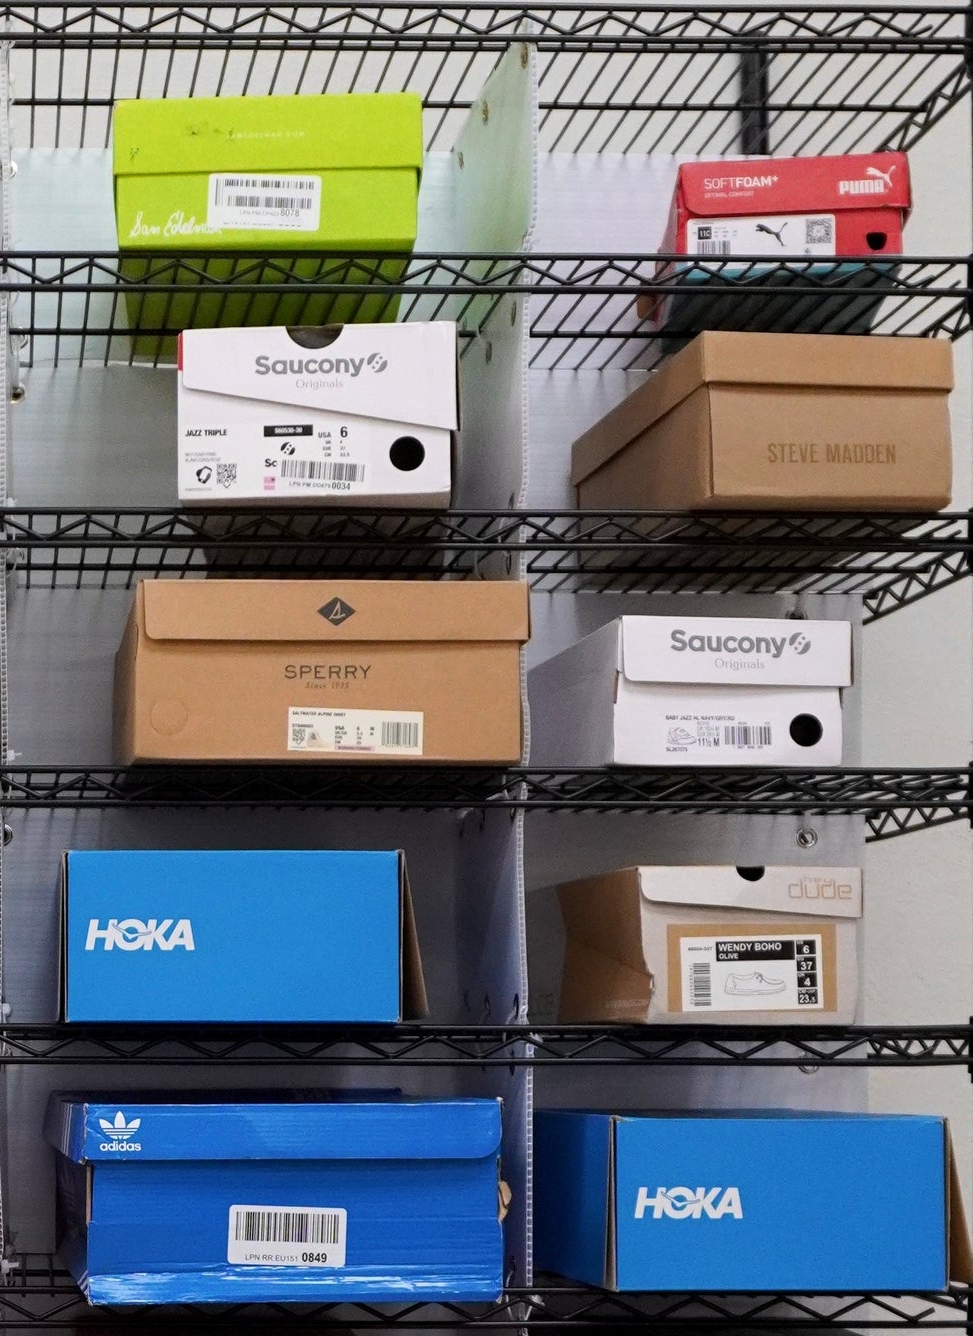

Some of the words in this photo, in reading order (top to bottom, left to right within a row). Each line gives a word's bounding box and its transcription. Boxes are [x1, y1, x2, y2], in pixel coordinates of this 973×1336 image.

[839, 179, 885, 194] PUMA
[280, 208, 300, 217] 8078
[130, 211, 160, 238] Sam
[255, 355, 365, 377] Saucony
[296, 378, 343, 389] Originals
[185, 429, 202, 437] JAZZ
[204, 428, 227, 436] TRIPLE
[340, 427, 348, 438] 6
[768, 443, 819, 463] STEVE
[826, 444, 896, 464] MADDEN
[331, 482, 351, 490] 0034
[670, 630, 787, 658] Saucony
[714, 658, 765, 670] Originals
[284, 664, 372, 680] SPERRY
[788, 879, 852, 900] dude
[85, 919, 195, 951] HOKA
[719, 943, 752, 952] WENDY
[755, 942, 782, 951] BOHO
[803, 946, 809, 954] 6
[801, 962, 813, 970] 37
[804, 979, 811, 987] 4
[799, 994, 816, 1004] 23.5
[99, 1140, 141, 1152] adidas
[634, 1186, 743, 1219] HOKA
[245, 1253, 261, 1262] LPN
[262, 1254, 274, 1262] RR
[301, 1251, 327, 1264] 0849
